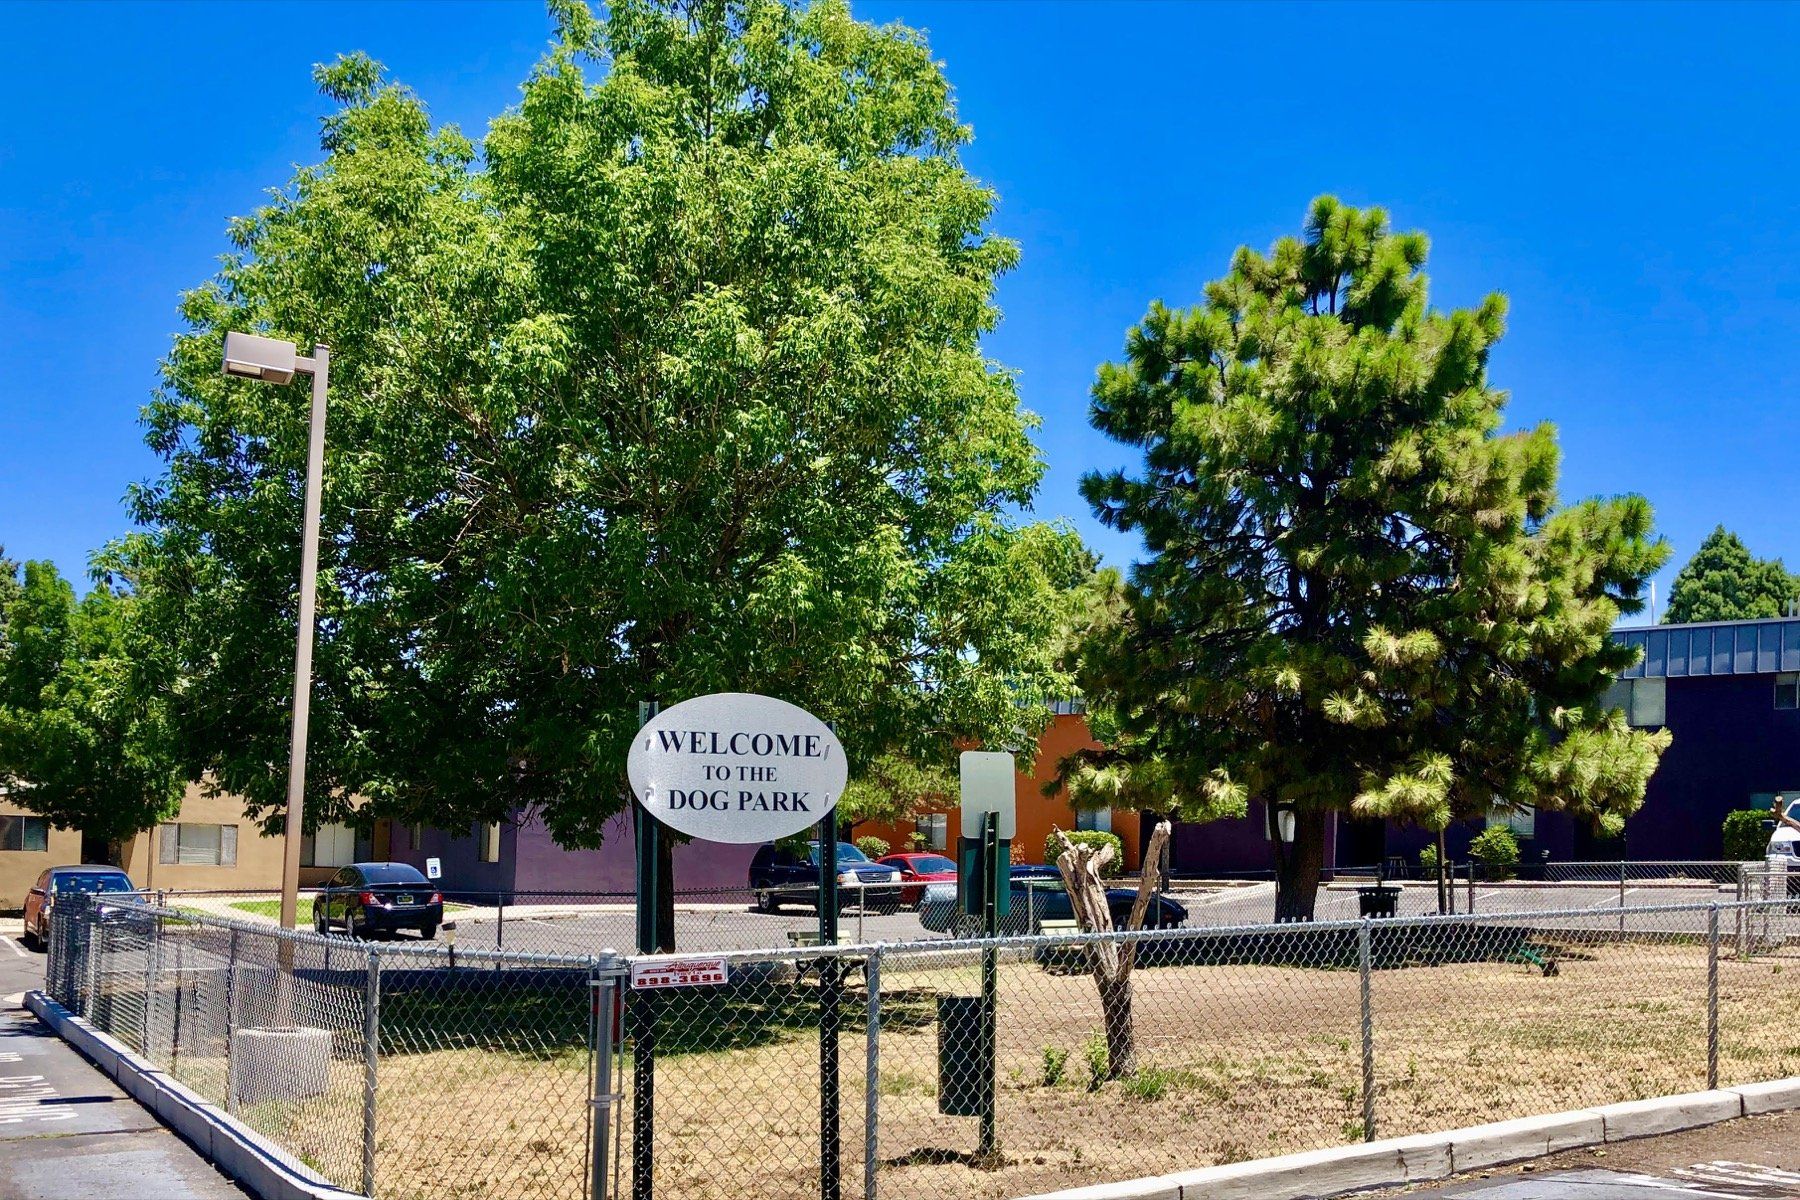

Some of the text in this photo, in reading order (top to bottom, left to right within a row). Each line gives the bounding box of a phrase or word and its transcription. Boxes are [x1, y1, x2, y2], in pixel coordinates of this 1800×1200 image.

[657, 730, 821, 758] WELCOME
[702, 765, 777, 782] TO THE
[668, 789, 810, 812] DOG PARK
